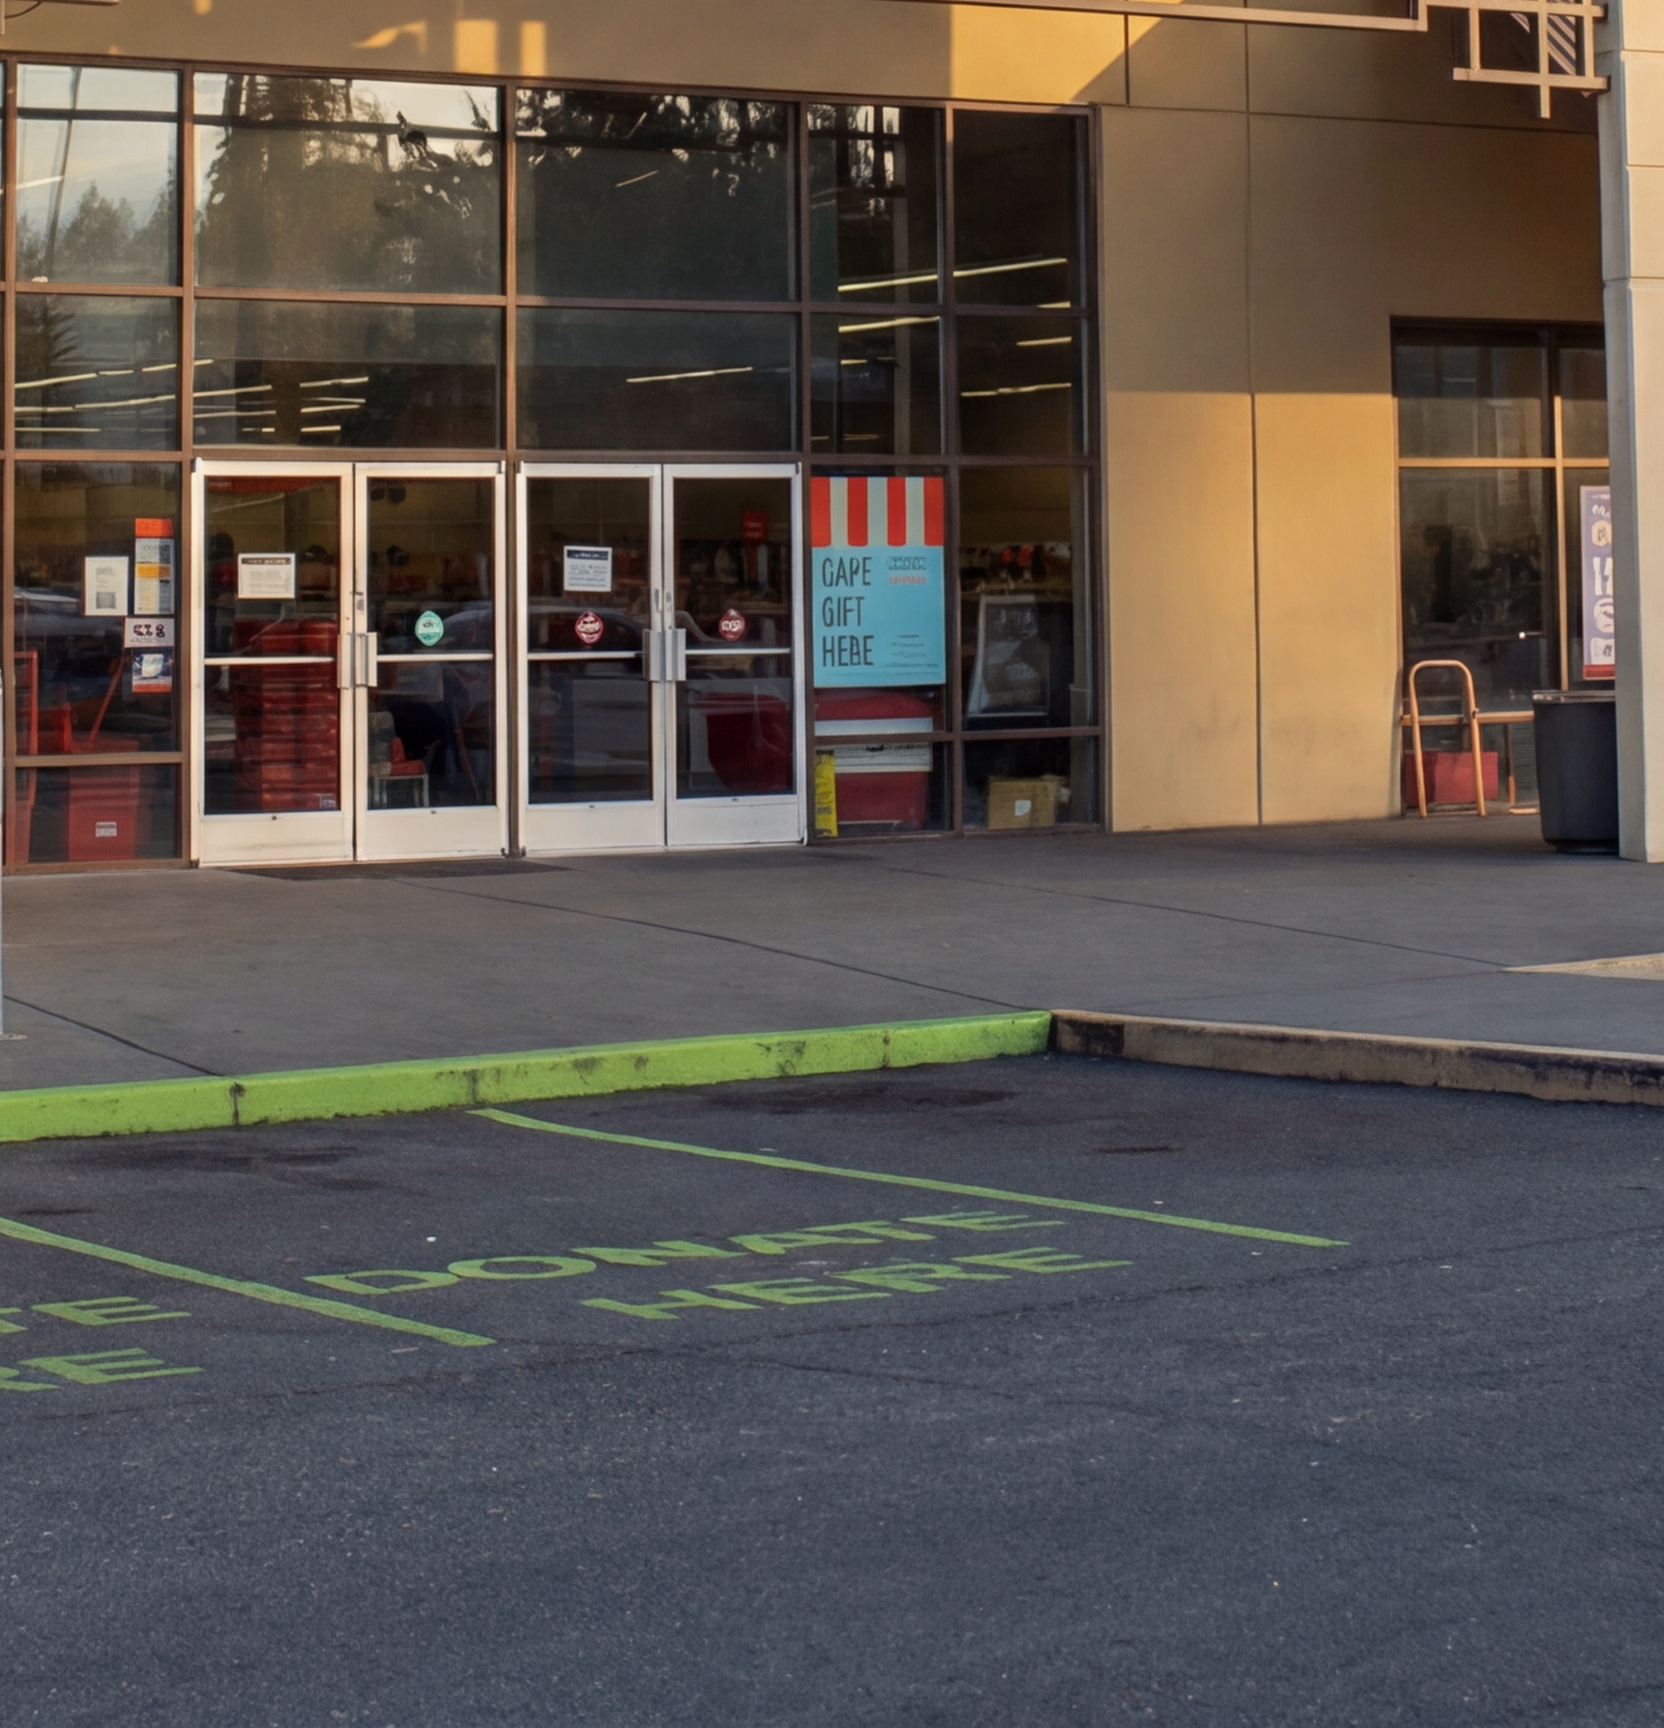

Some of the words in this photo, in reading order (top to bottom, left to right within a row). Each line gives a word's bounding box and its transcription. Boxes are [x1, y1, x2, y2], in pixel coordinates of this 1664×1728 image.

[821, 596, 865, 627] GIFT
[303, 1211, 1066, 1295] DONATE
[580, 1247, 1133, 1319] HERE
